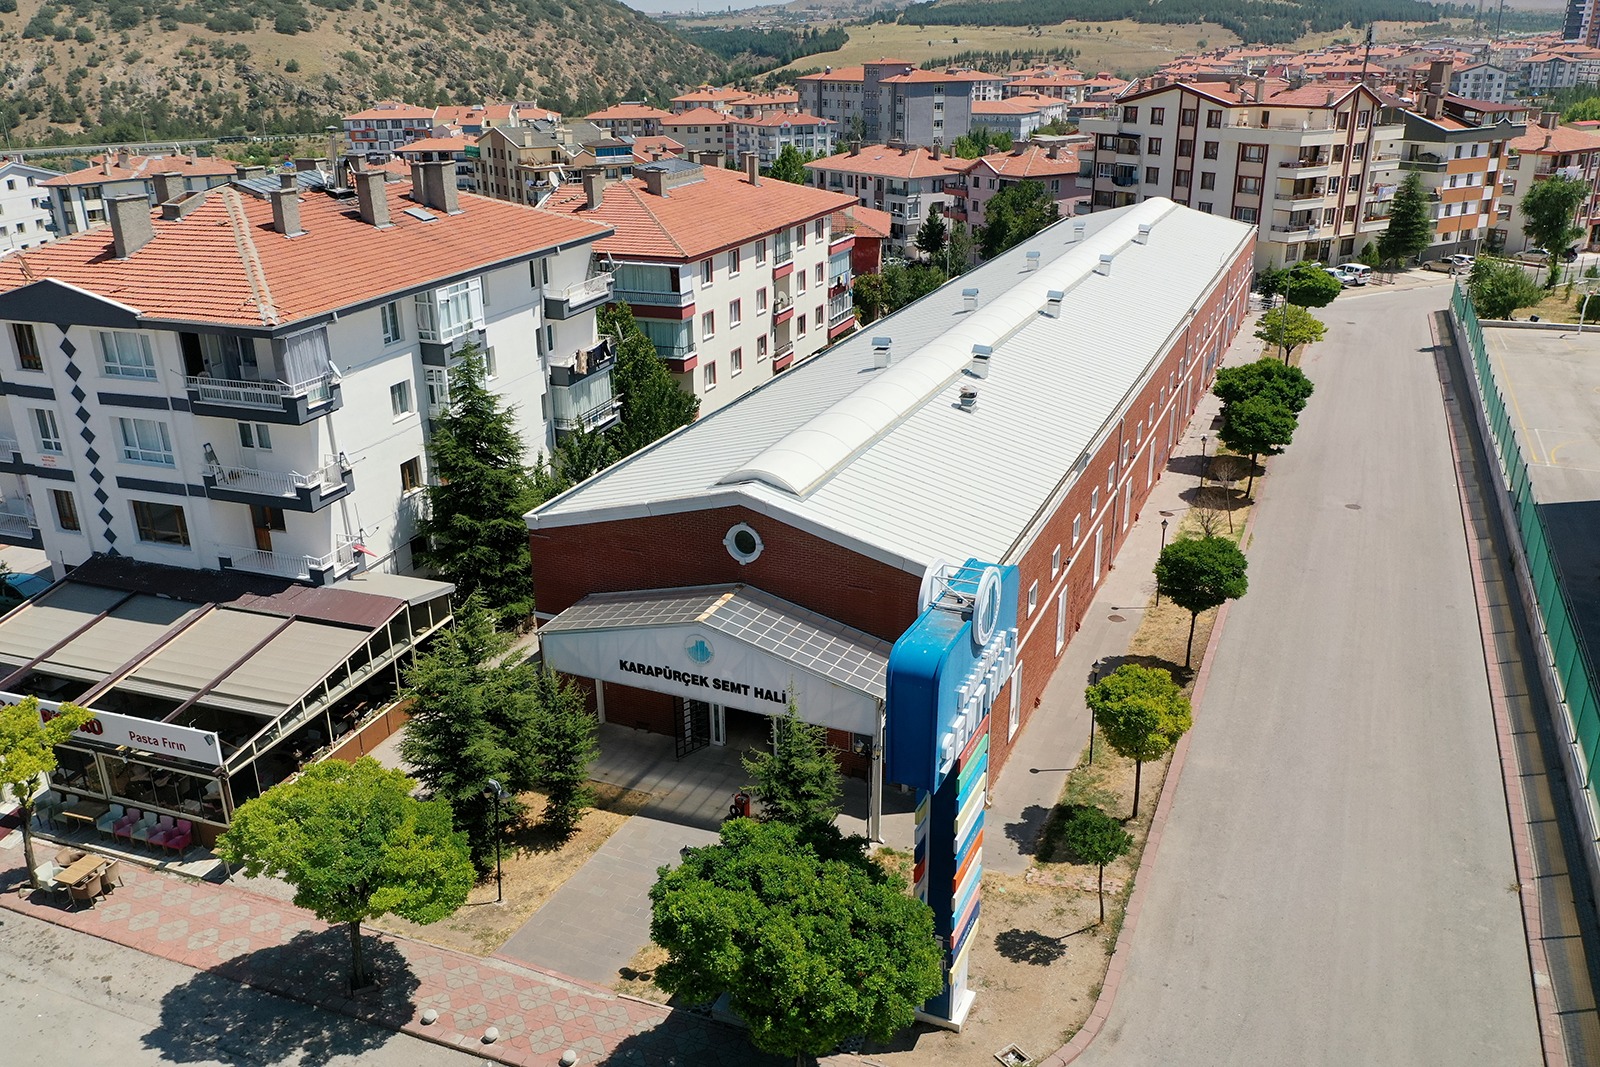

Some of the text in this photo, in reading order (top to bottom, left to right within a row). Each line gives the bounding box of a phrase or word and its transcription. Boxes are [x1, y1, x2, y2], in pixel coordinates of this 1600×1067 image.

[619, 659, 787, 704] KARAPÜRÇEK SEMT HALİ
[128, 730, 187, 752] Pasta Fırın
[939, 683, 987, 774] SEMT
